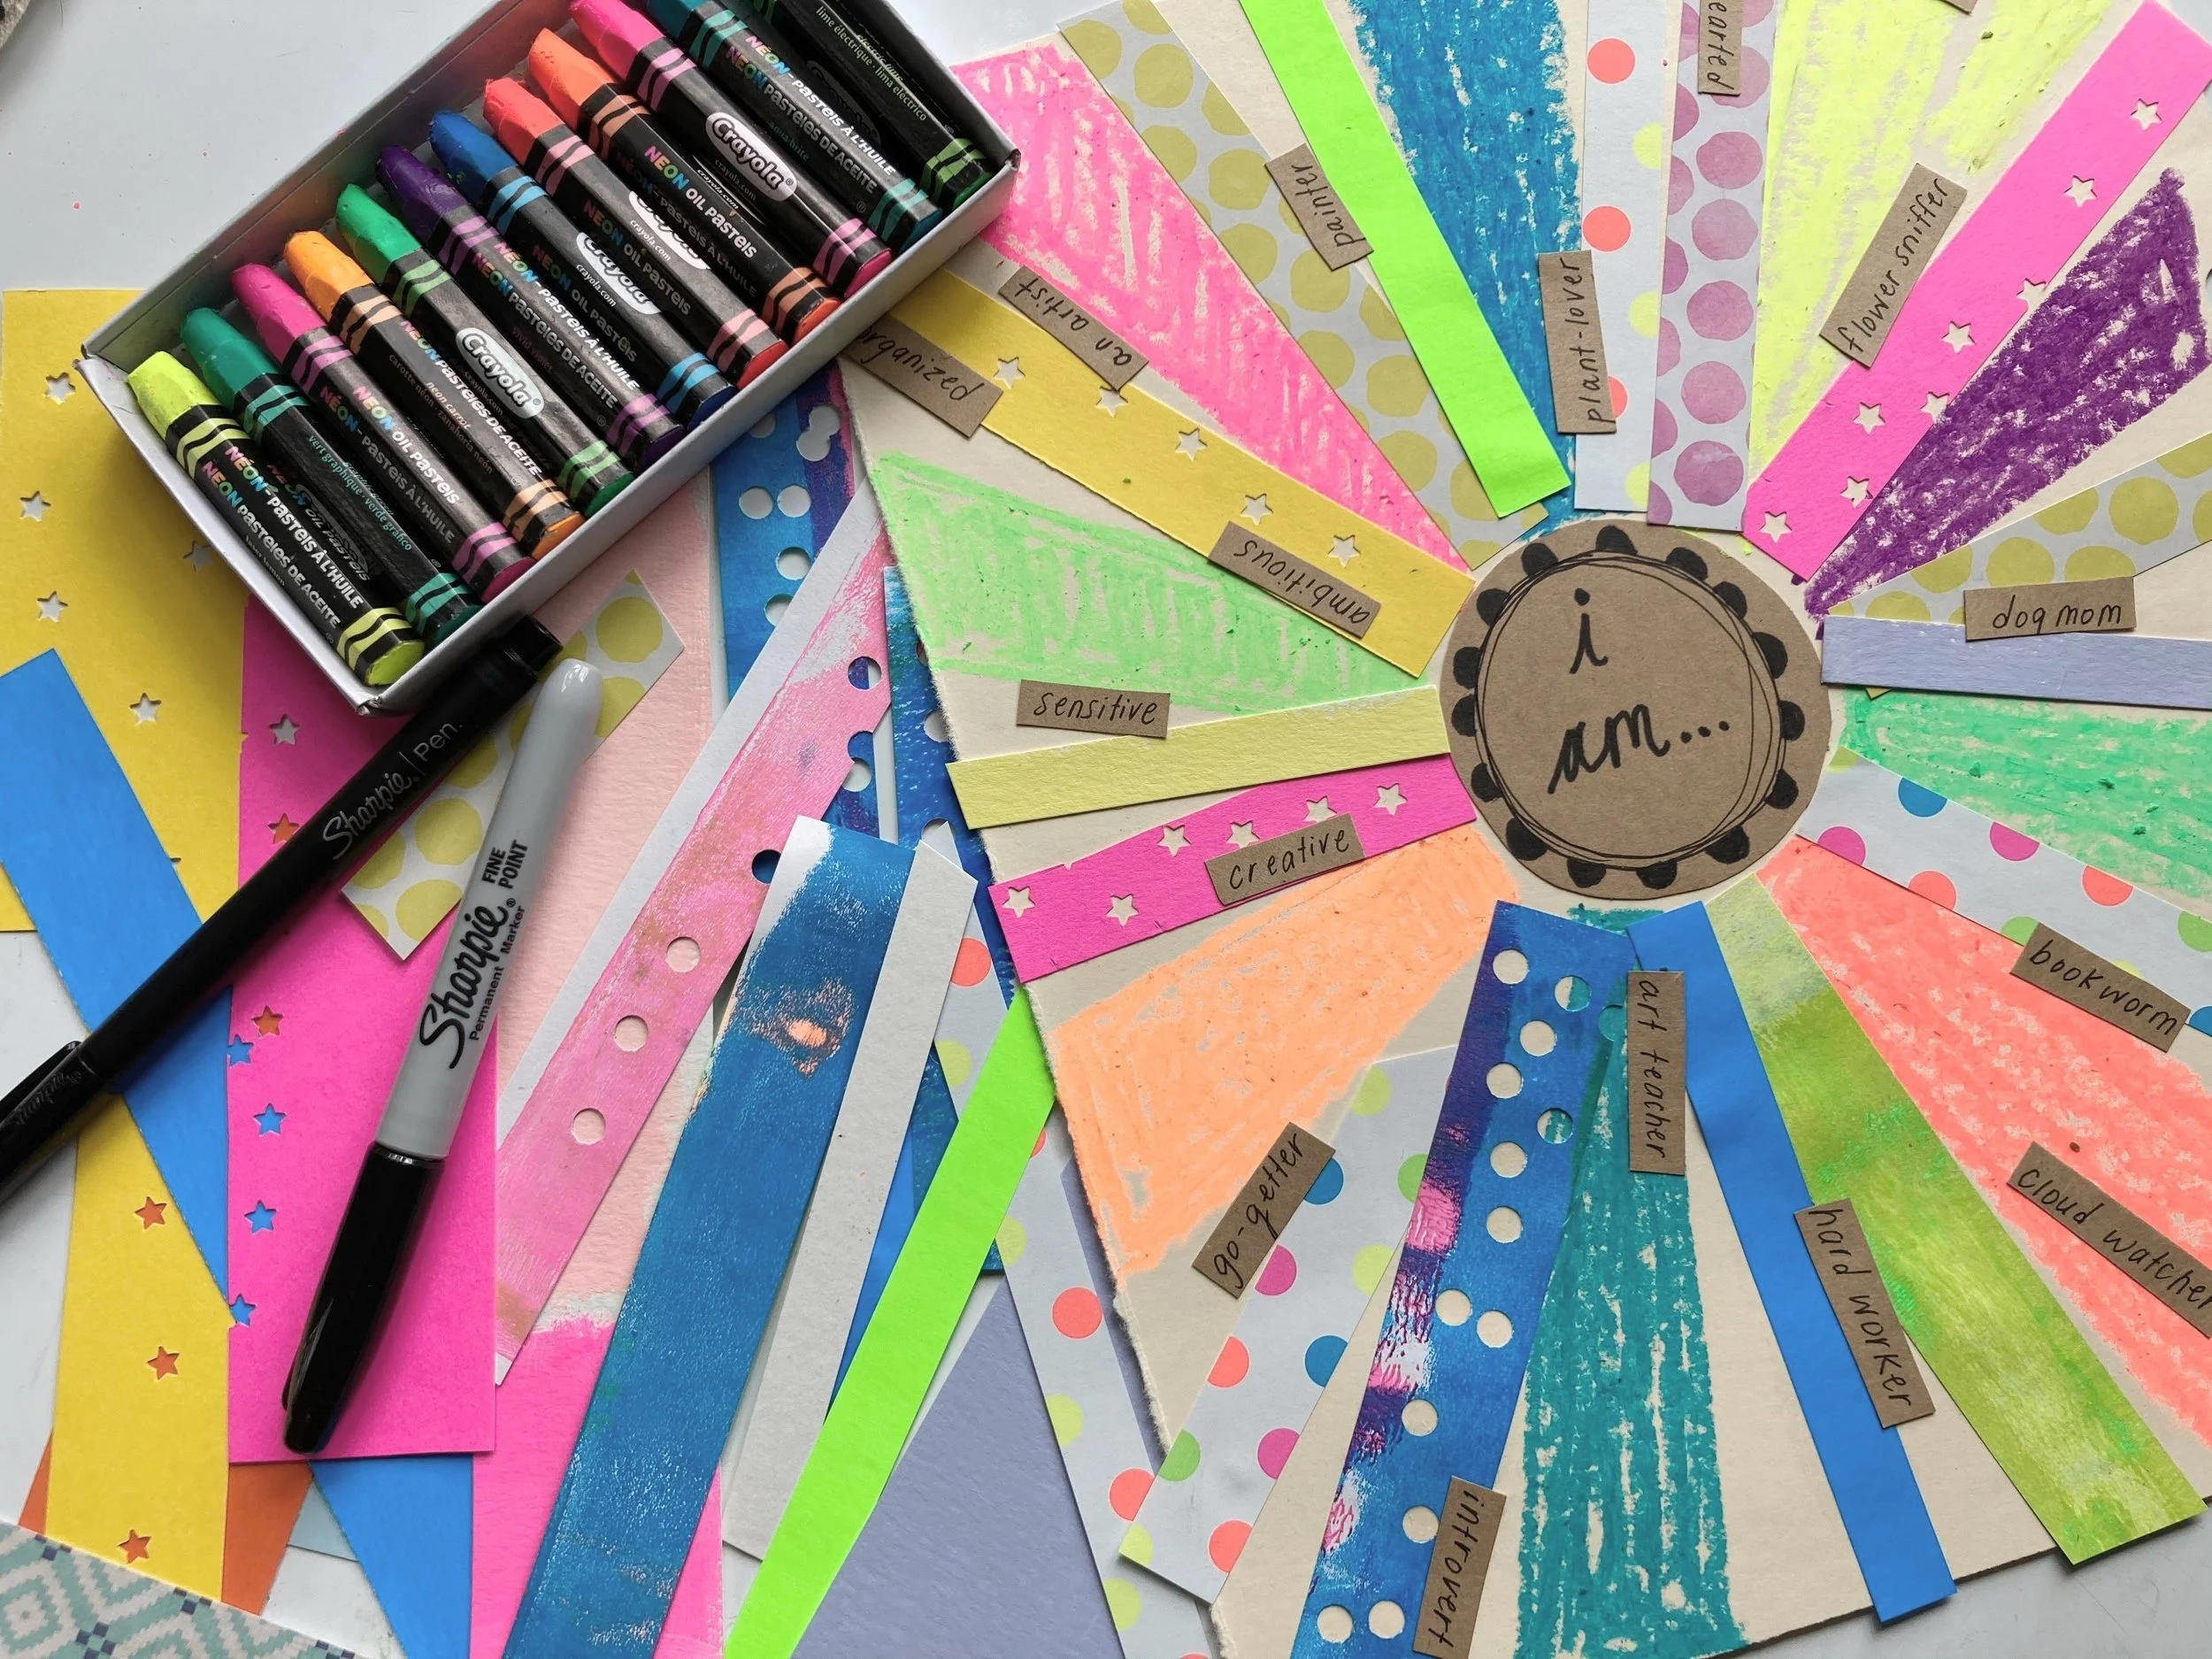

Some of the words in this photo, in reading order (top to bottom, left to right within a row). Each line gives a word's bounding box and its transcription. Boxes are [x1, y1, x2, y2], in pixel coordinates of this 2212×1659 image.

[816, 5, 835, 27] lime
[875, 65, 894, 88] lima
[712, 118, 784, 190] Crayola
[726, 45, 768, 91] NEON
[819, 135, 838, 157] DE
[834, 151, 878, 193] ACEITE
[644, 145, 689, 190] NEON
[686, 188, 706, 211] OIL
[695, 170, 739, 209] crayola.com
[715, 159, 756, 201] crayola.com
[1291, 163, 1367, 248] painter
[583, 200, 623, 246] NEON
[624, 243, 641, 268] OIL
[629, 219, 671, 262] crayola.com
[1837, 269, 1901, 353] flower
[1895, 178, 1948, 266] sniffer
[532, 244, 572, 290] NEON
[572, 289, 588, 313] OIL
[576, 264, 616, 307] crayola.com
[1014, 277, 1090, 332] artist
[472, 253, 513, 299] NEON
[561, 347, 580, 369] DE
[575, 365, 618, 409] ACEITE
[1095, 337, 1133, 366] an
[1560, 257, 1617, 423] plant-lover
[400, 319, 441, 361] NEON
[487, 417, 506, 434] DE
[499, 434, 542, 476] ACEITE
[462, 333, 531, 407] Crayola
[464, 372, 503, 416] crayola.com
[353, 385, 396, 432] NEON
[392, 431, 412, 453] OIL
[425, 382, 447, 403] neon
[444, 403, 471, 430] carrot
[308, 435, 326, 454] vert
[321, 453, 363, 495] graphique
[365, 497, 389, 522] verde
[203, 461, 242, 508] NEON
[288, 565, 306, 586] DE
[301, 584, 341, 628] ACEITE
[304, 509, 324, 528] OIL
[1233, 540, 1371, 625] ambitious
[2055, 604, 2122, 627] mom
[1571, 588, 1608, 674] i
[1033, 691, 1157, 726] sensitive
[322, 771, 413, 861] Sharpie
[481, 847, 506, 884] FINE
[499, 840, 528, 889] POINT
[1228, 826, 1350, 891] creative
[419, 904, 510, 1070] Sharpie
[469, 966, 504, 1041] Permanent
[503, 905, 526, 954] Marker
[1637, 979, 1668, 1032] art
[1640, 1048, 1671, 1158] teacher
[1213, 1133, 1303, 1289] go-getter
[2017, 1169, 2105, 1225] cloud
[1808, 1209, 1873, 1275] hard
[1848, 1294, 1912, 1407] worker
[1427, 1489, 1485, 1647] introvert
